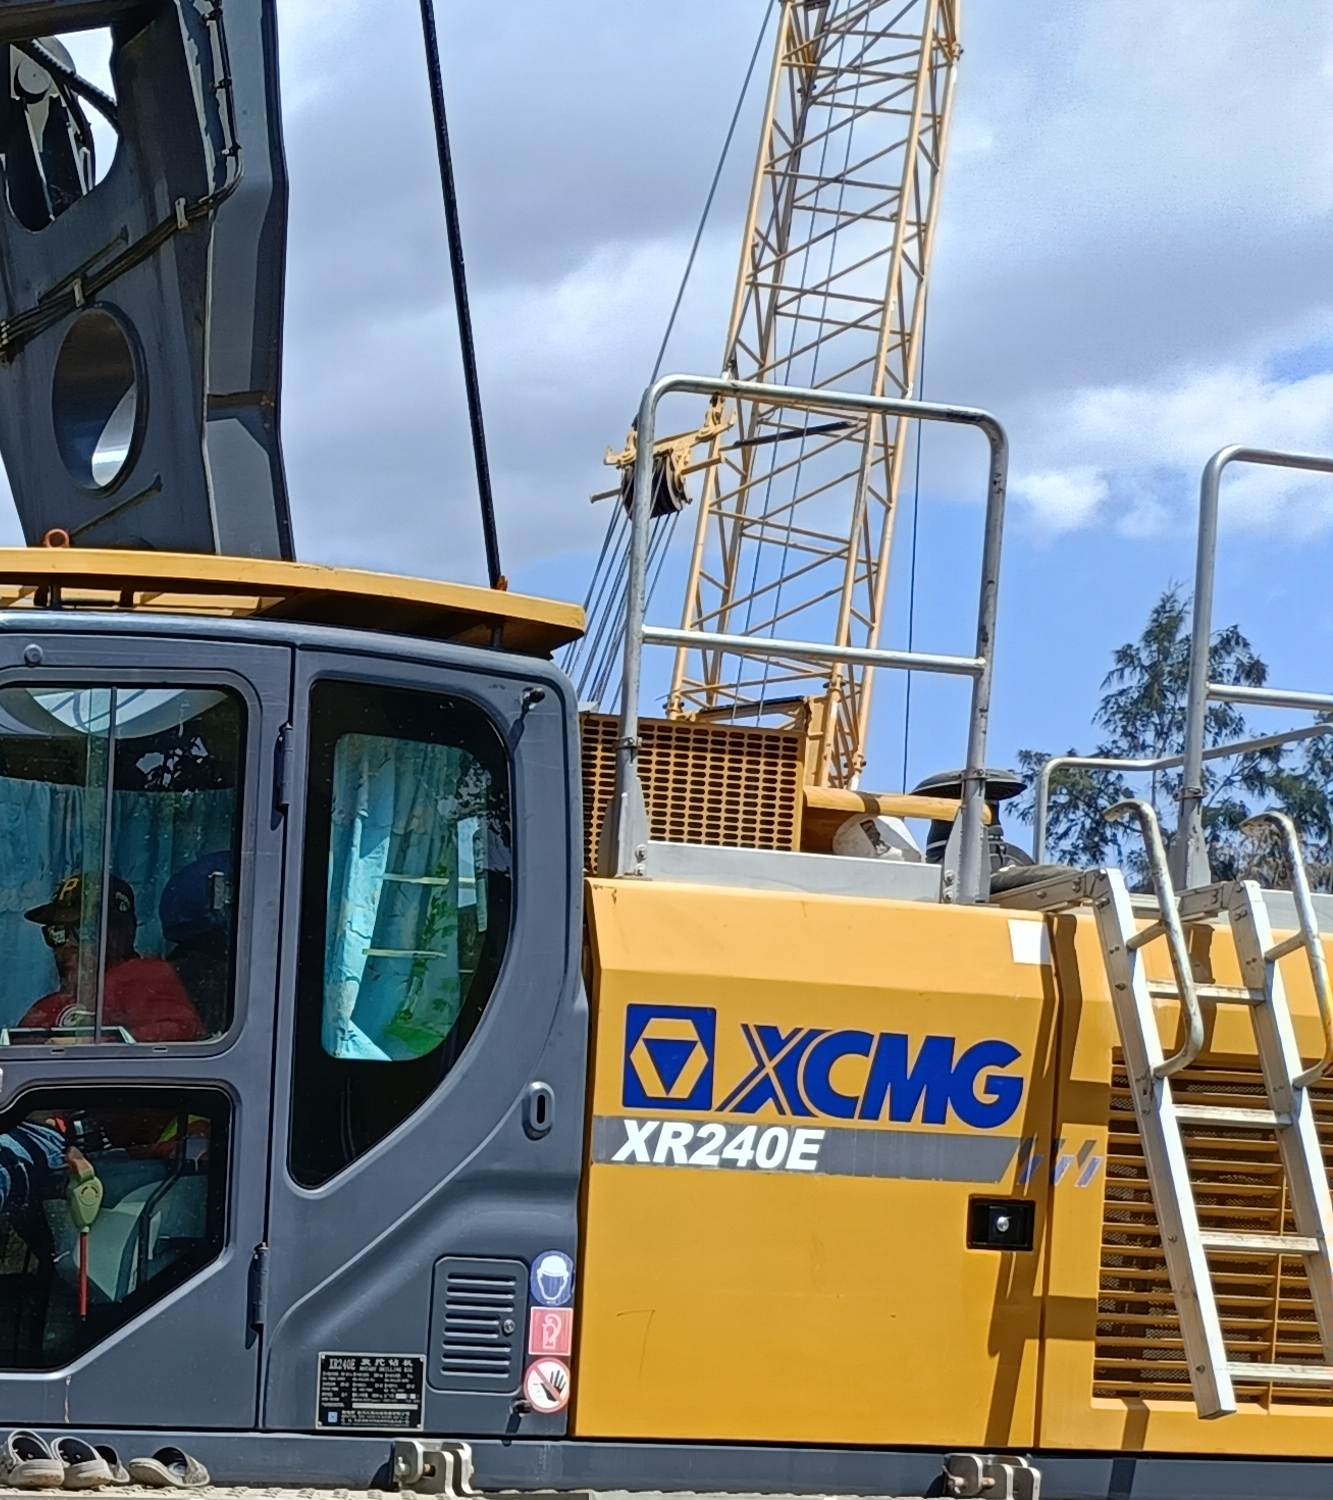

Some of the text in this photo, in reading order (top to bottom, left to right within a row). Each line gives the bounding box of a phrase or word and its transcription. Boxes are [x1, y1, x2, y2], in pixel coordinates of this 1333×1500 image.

[58, 878, 80, 900] P
[715, 1023, 1024, 1129] XCMG
[611, 1119, 825, 1171] XR240E
